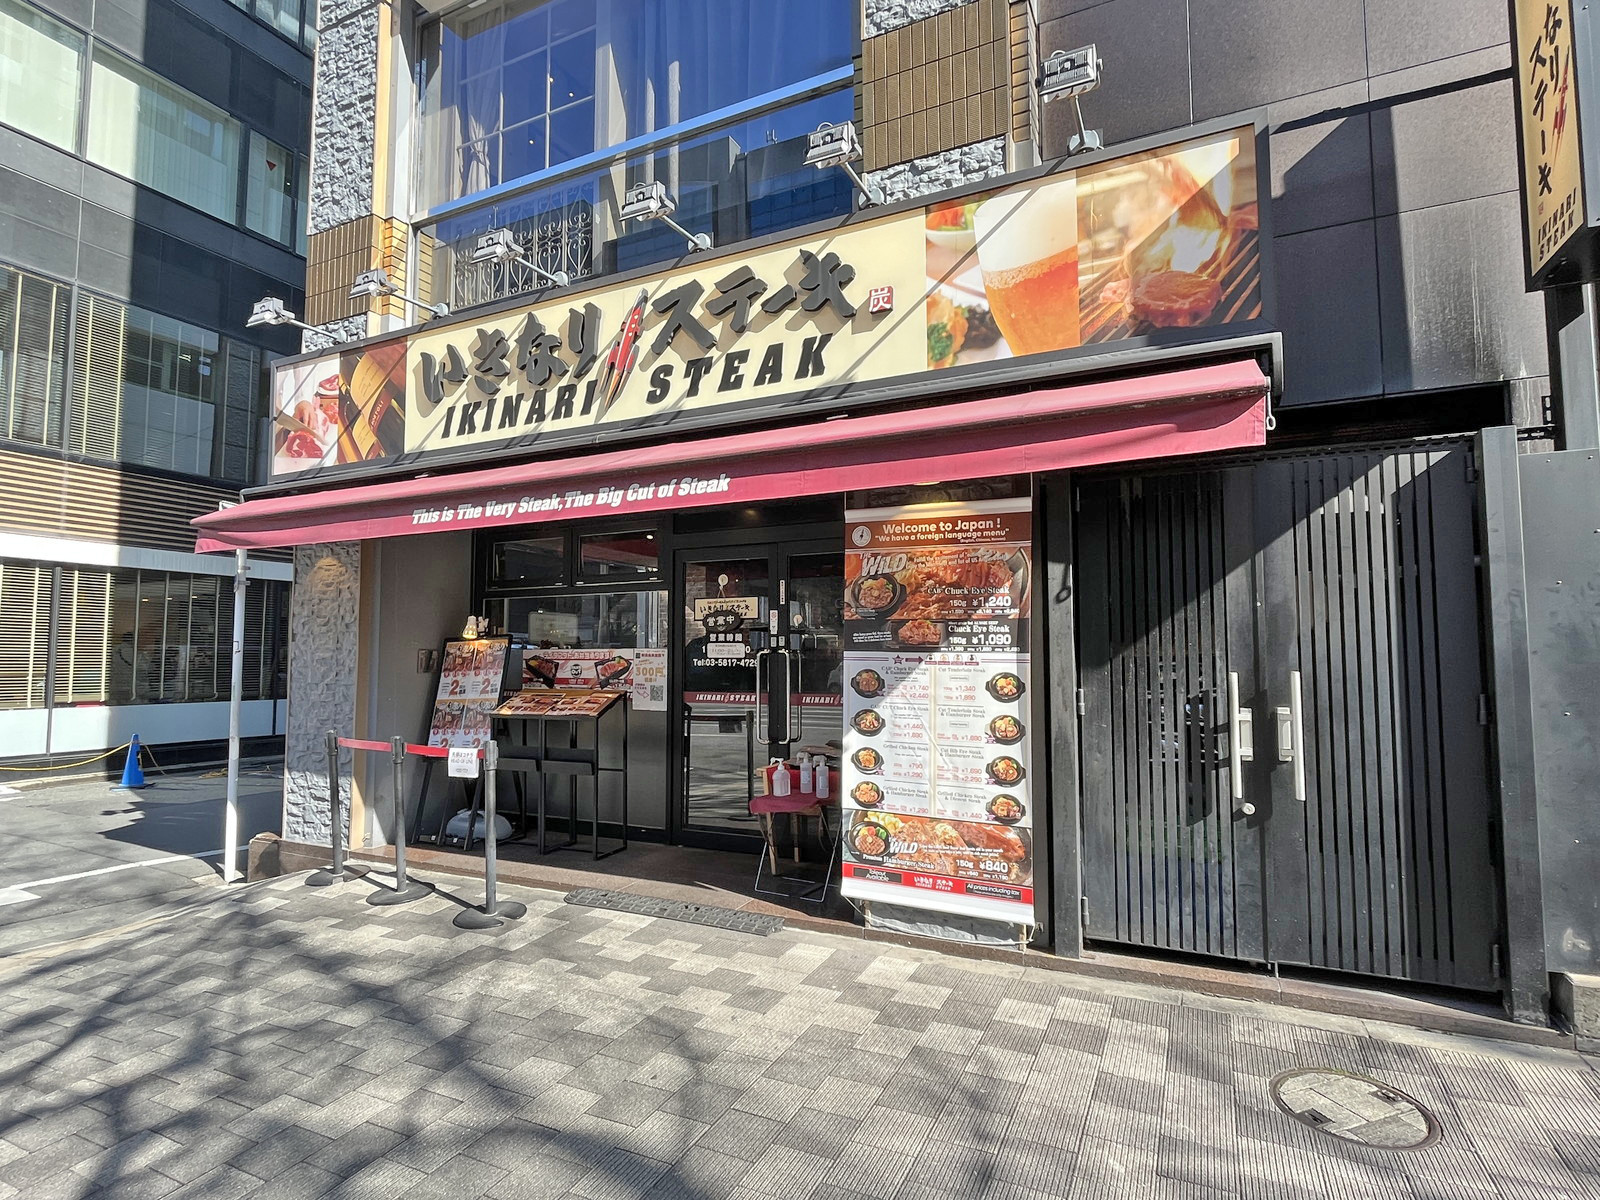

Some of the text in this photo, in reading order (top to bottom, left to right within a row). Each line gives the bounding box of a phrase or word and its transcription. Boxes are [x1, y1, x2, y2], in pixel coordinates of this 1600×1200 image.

[1529, 35, 1552, 197] ステーキ
[1538, 187, 1577, 245] IKINARI
[1539, 209, 1575, 262] STEAK
[869, 286, 894, 314] 炭
[420, 249, 857, 404] いきなり ステーキ
[441, 333, 834, 439] IKINARI STEAK
[412, 508, 441, 525] This
[441, 507, 454, 521] is
[457, 503, 482, 520] The
[485, 501, 516, 519] Very
[596, 486, 623, 507] Big
[626, 482, 654, 501] Cut
[657, 479, 675, 497] of
[677, 474, 731, 496] Steak
[882, 518, 1001, 534] Welcome to Japan !
[891, 534, 909, 542] have
[916, 532, 944, 542] foreign
[945, 530, 982, 541] language
[945, 586, 968, 595] Chuck
[971, 587, 986, 595] Eye
[987, 586, 1010, 594] Steak
[972, 596, 1011, 608] ¥1,240
[707, 615, 735, 627] 営業中
[948, 625, 1010, 634] Chuck Eye Steak
[949, 634, 1011, 645] 150g ¥1,090
[635, 667, 665, 678] 300円
[890, 841, 918, 854] WILD
[884, 856, 917, 868] Hamburger
[917, 861, 935, 869] Steak
[957, 860, 1008, 873] 150g ¥840
[973, 884, 988, 892] prices
[988, 886, 1011, 896] including
